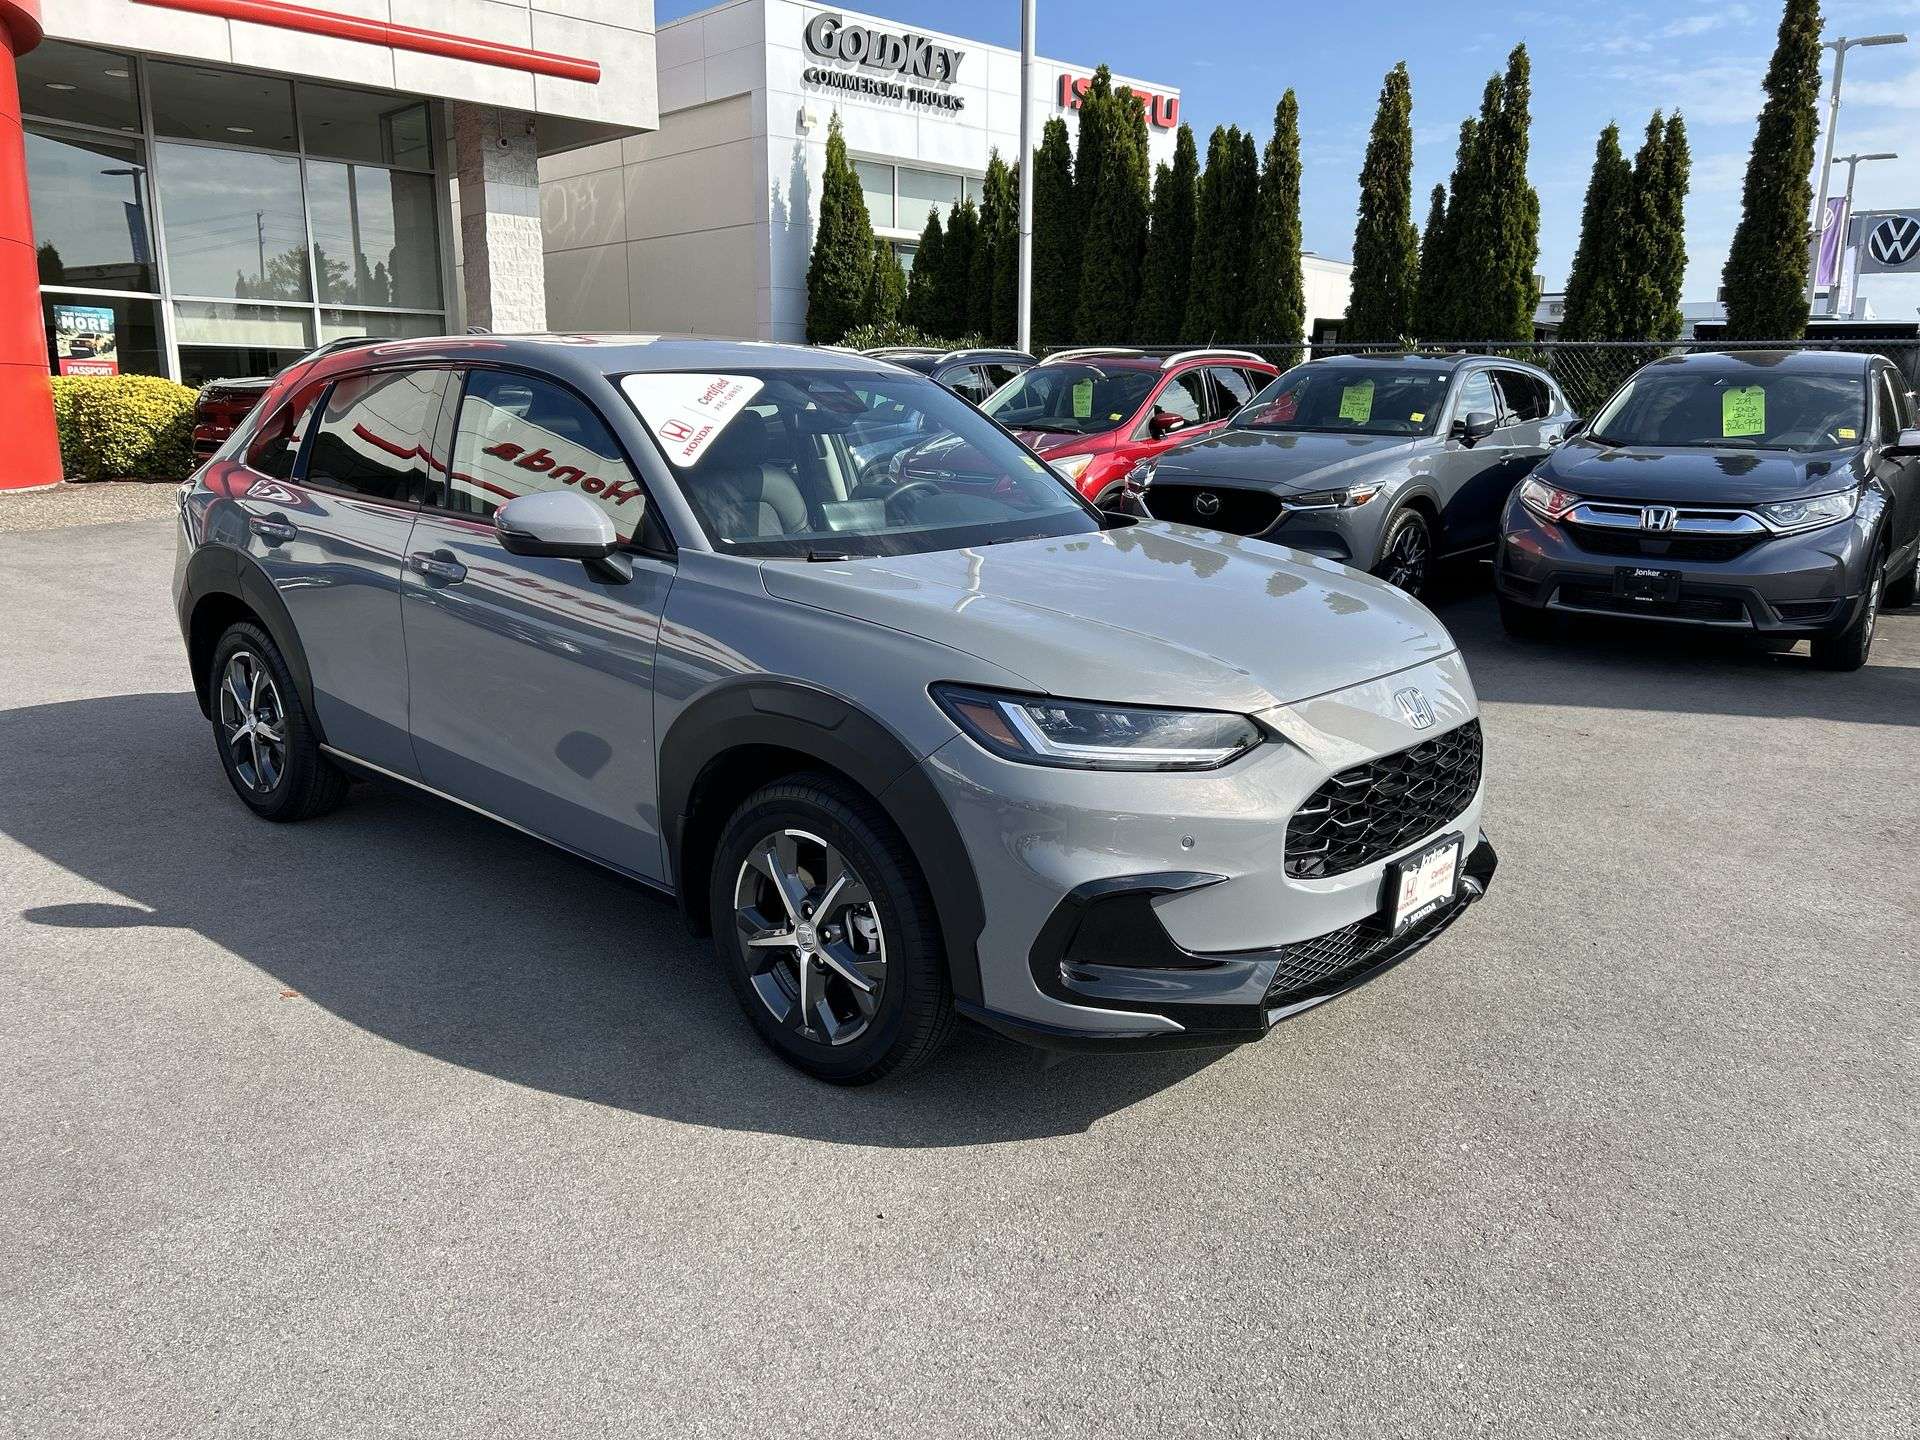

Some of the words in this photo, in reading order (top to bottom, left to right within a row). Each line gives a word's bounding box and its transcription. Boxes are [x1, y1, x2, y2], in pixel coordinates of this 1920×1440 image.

[802, 12, 965, 84] GOLDKEY
[803, 67, 908, 100] COMMERCIAL
[910, 87, 965, 111] TRUCKS
[61, 316, 110, 331] MORE
[67, 365, 113, 375] PASSPORT
[697, 377, 729, 405] Certified
[682, 424, 714, 457] HONDA
[1410, 902, 1437, 923] HONDA
